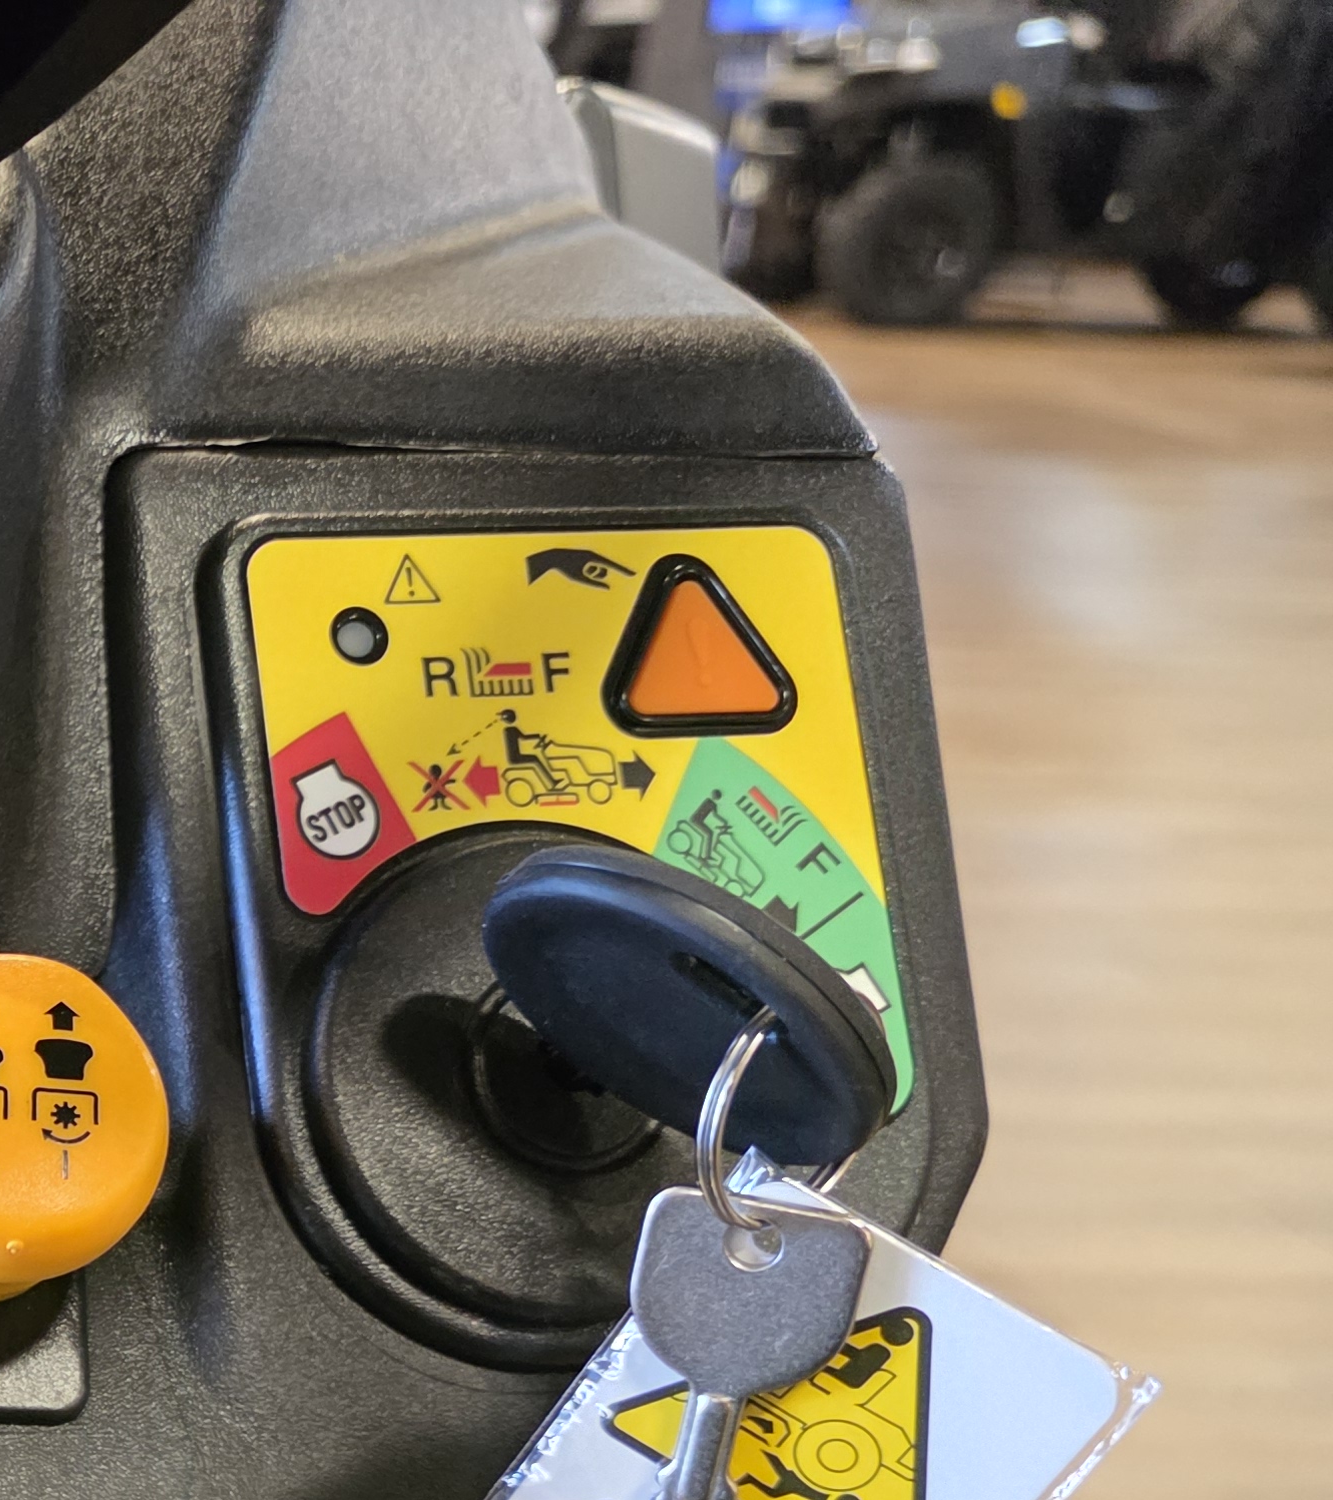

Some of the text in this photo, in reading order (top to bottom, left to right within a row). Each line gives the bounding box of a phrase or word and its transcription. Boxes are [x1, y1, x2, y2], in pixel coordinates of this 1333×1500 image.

[421, 652, 570, 698] R F
[306, 794, 365, 842] STOP
[796, 842, 841, 874] F
